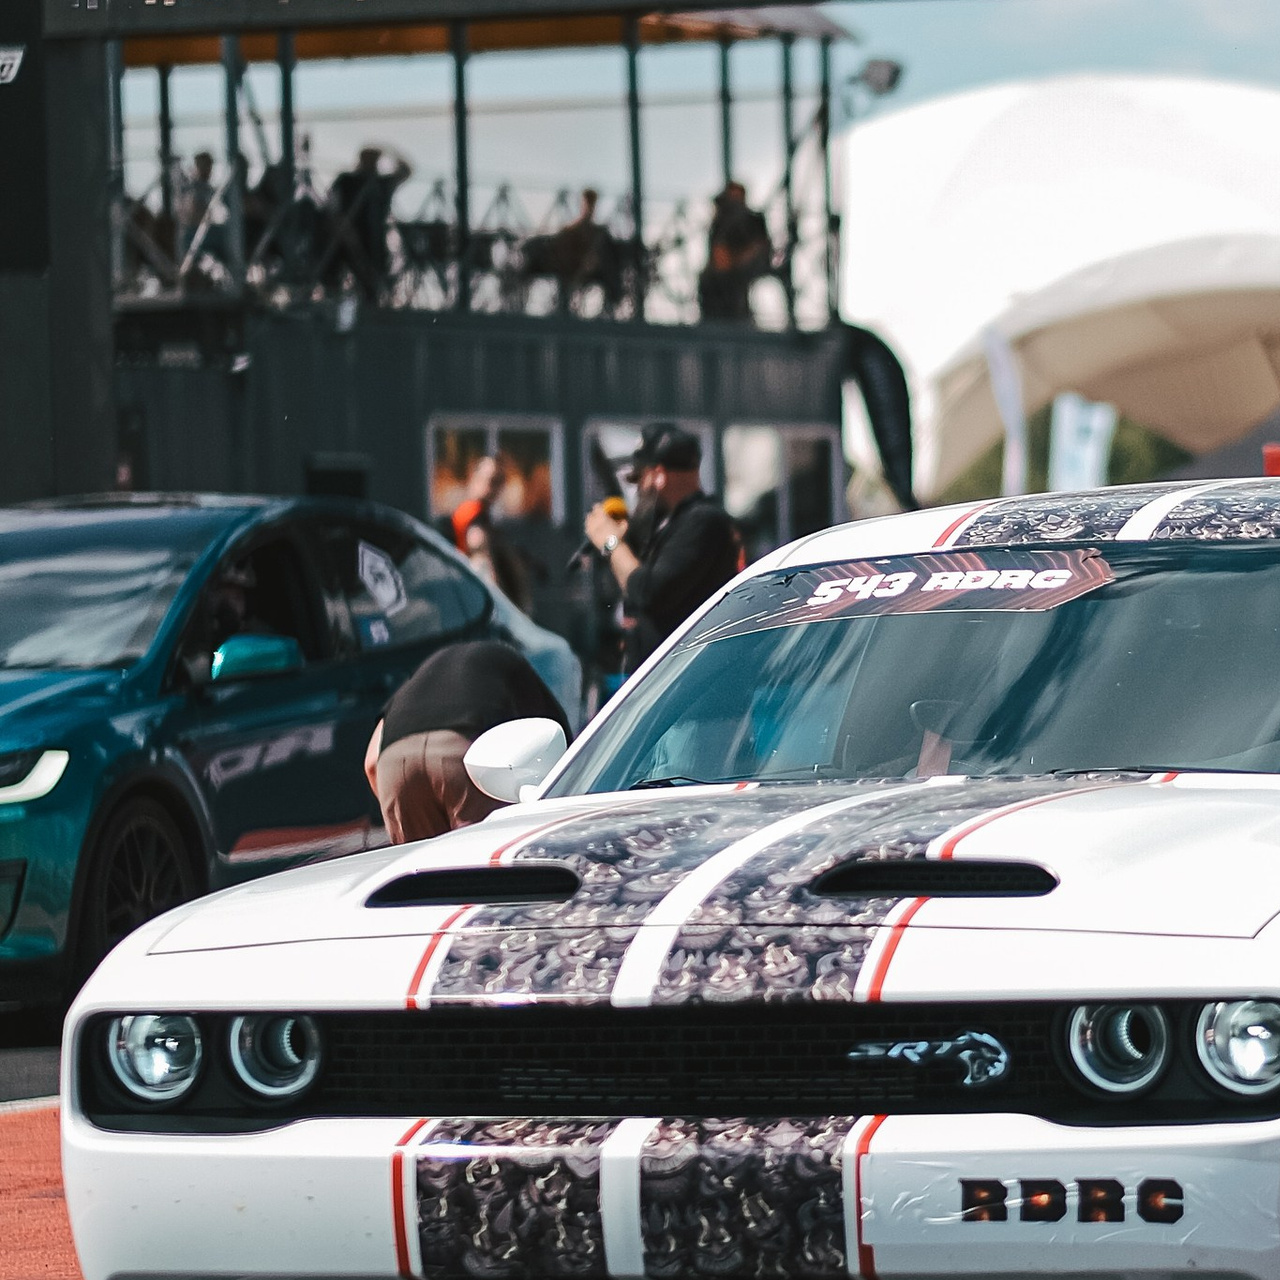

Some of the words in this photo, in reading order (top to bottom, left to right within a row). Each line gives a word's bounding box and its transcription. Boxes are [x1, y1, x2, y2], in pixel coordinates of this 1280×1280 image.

[806, 572, 917, 607] 543
[848, 1041, 966, 1062] SRT
[958, 1177, 1184, 1224] RDRC
